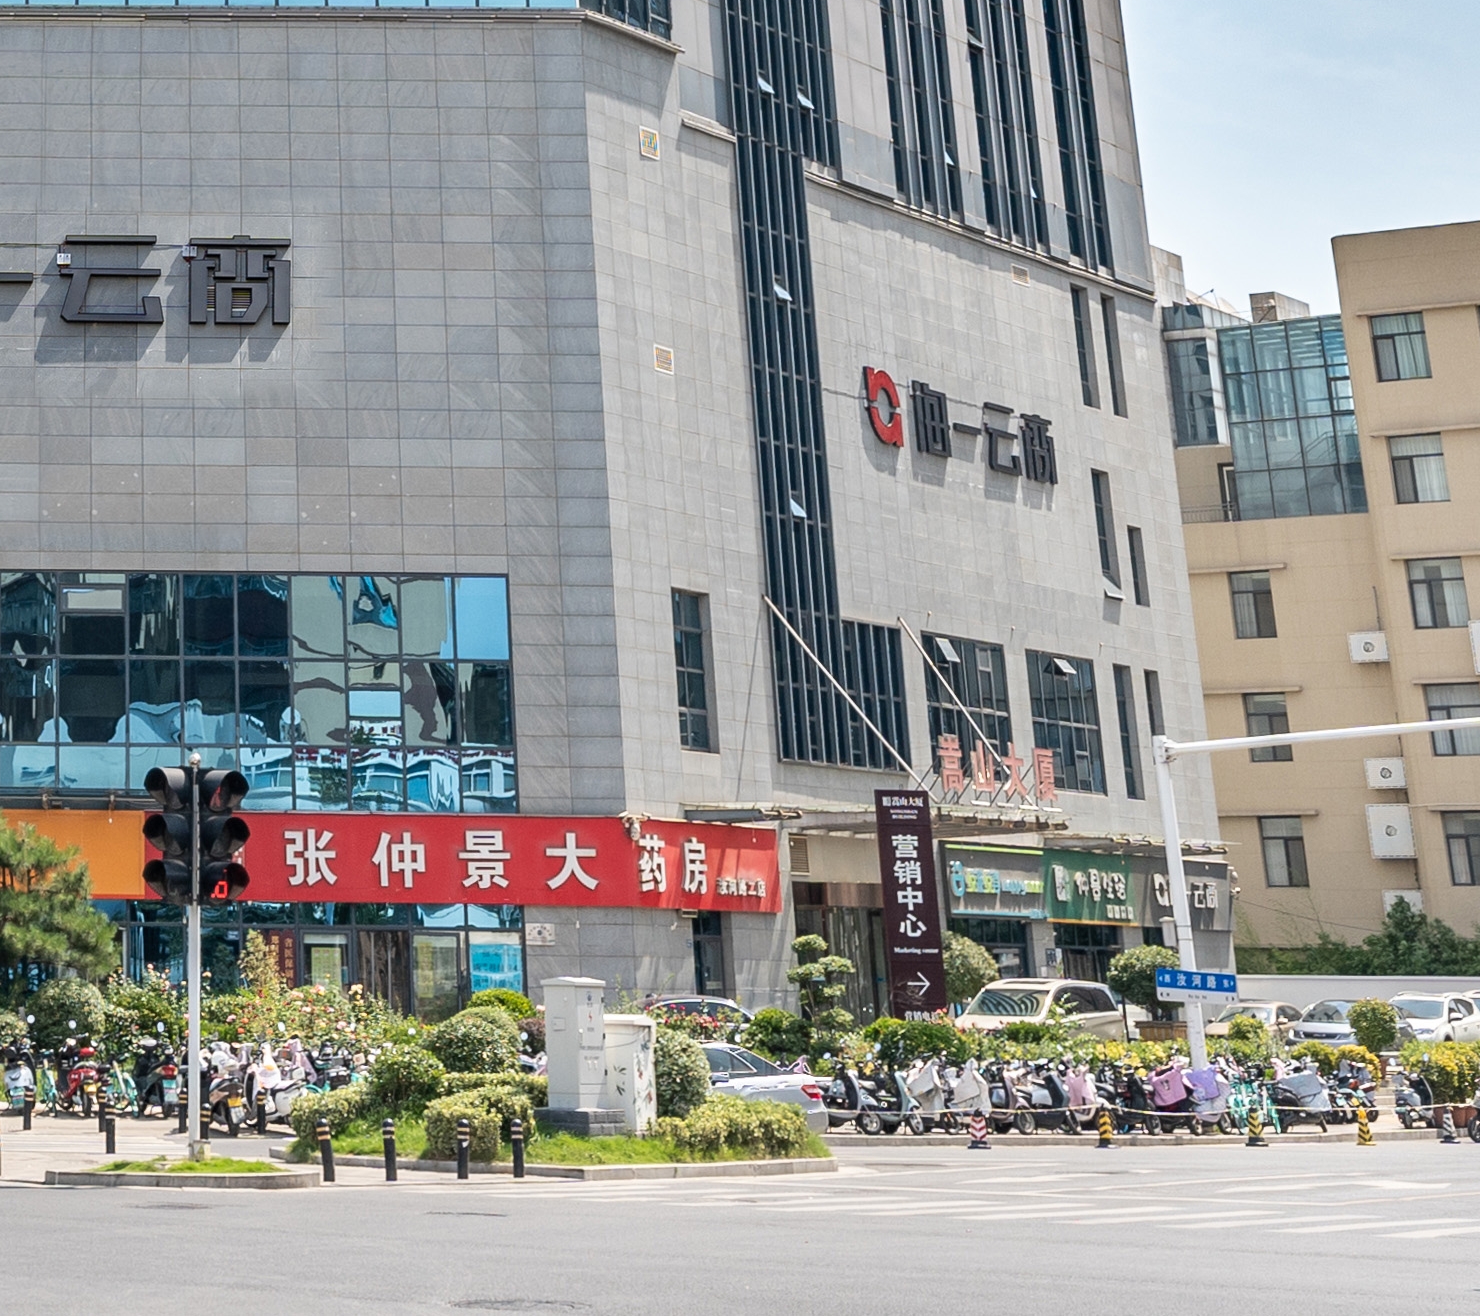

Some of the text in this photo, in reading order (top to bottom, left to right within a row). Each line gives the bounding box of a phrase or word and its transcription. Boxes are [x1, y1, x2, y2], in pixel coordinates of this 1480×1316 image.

[911, 379, 1059, 485] 海一云商
[936, 733, 1059, 802] 嵩山大厦
[283, 829, 708, 894] 张仲景大药房
[890, 834, 928, 938] 营销中心
[1176, 972, 1217, 990] 汝河路
